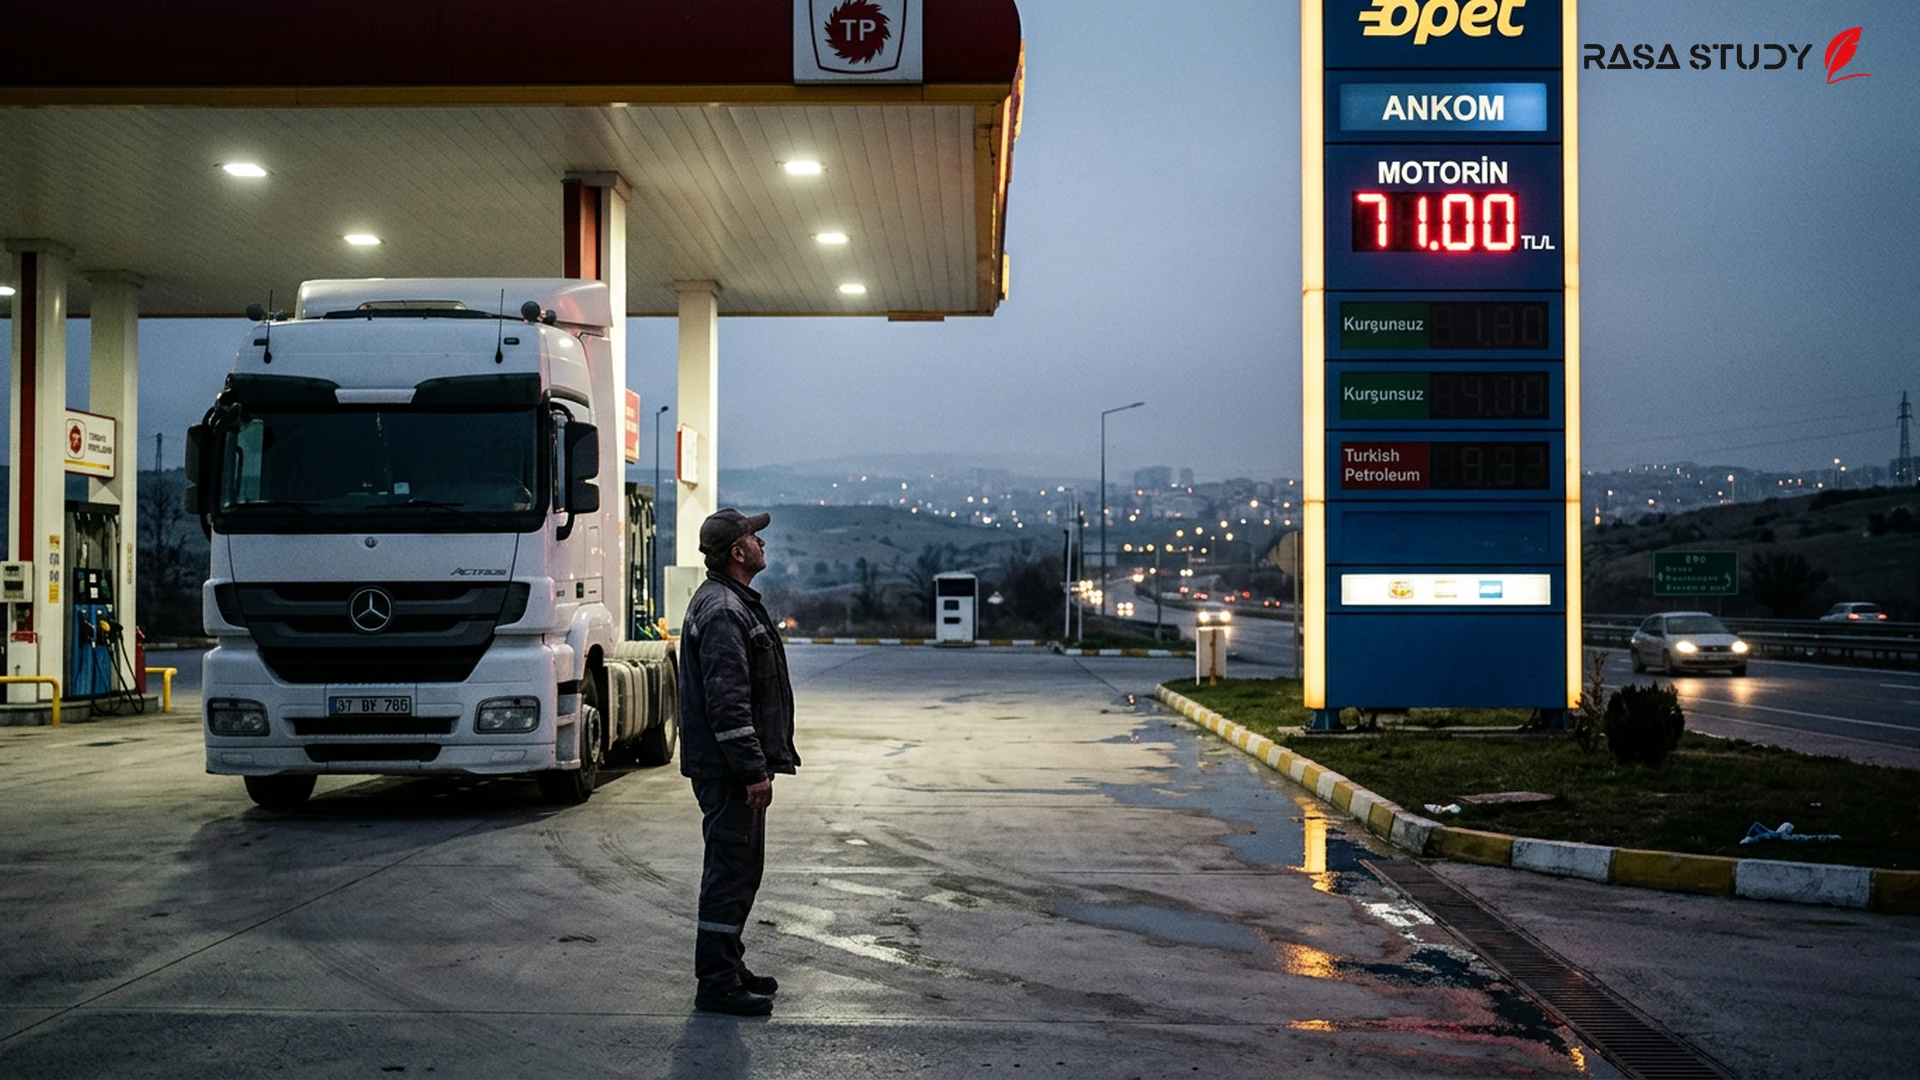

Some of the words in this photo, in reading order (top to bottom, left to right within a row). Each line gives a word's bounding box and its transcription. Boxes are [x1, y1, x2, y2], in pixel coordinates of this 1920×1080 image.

[839, 19, 876, 41] TP
[1382, 95, 1505, 121] ANKOM
[1378, 156, 1508, 184] MOTORİN
[1357, 193, 1515, 251] 71.00
[1344, 448, 1400, 463] Turkish
[1344, 467, 1421, 483] Petroleum
